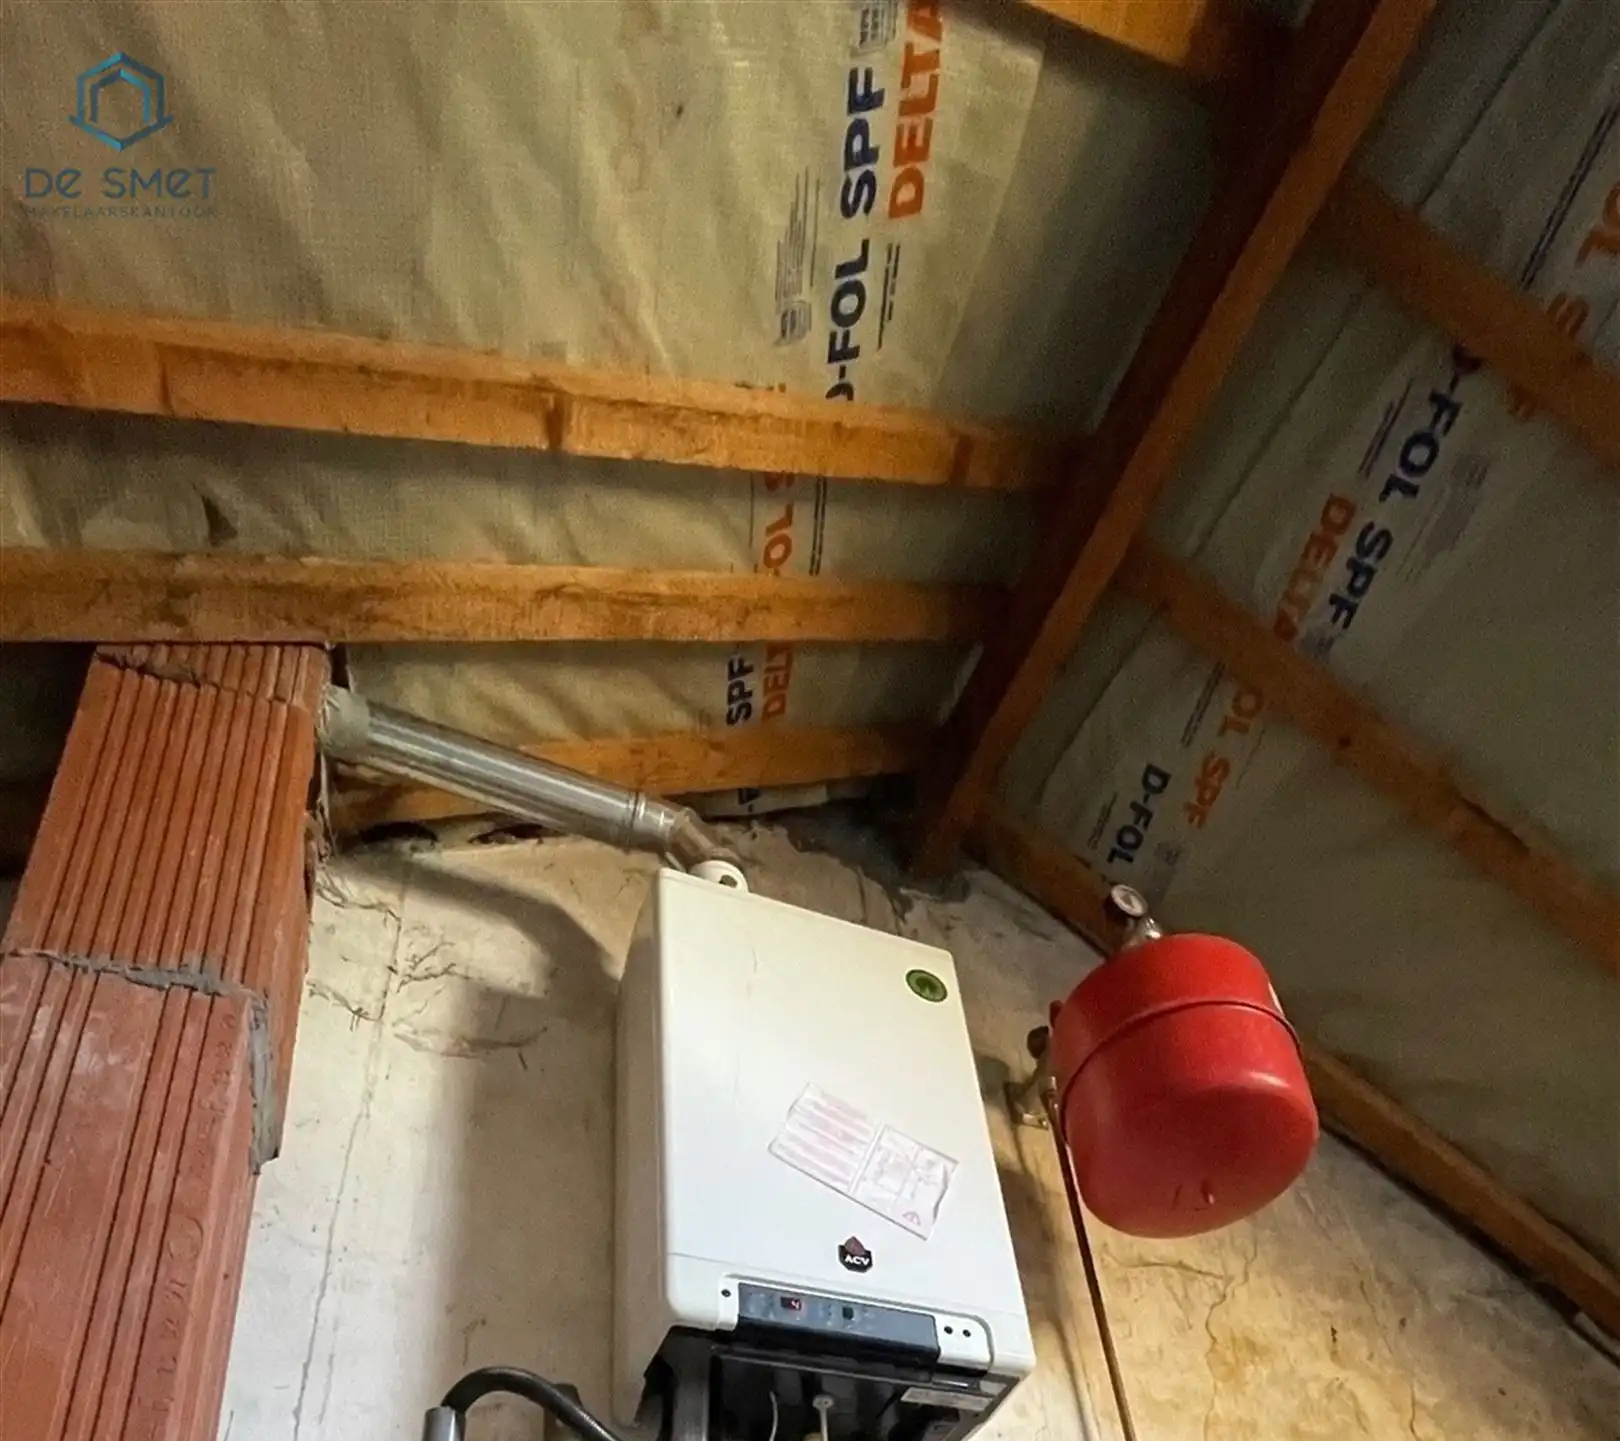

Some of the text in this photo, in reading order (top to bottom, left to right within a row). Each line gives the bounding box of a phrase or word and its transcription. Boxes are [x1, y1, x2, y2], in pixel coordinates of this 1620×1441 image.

[840, 66, 885, 219] SPF
[889, 0, 943, 219] DELTA
[1329, 521, 1393, 629] SPF
[726, 656, 753, 726] SPF
[762, 643, 792, 722] DELT
[1107, 763, 1172, 864] D-FOL
[1184, 752, 1230, 829] SPF
[844, 1254, 870, 1266] ACV
